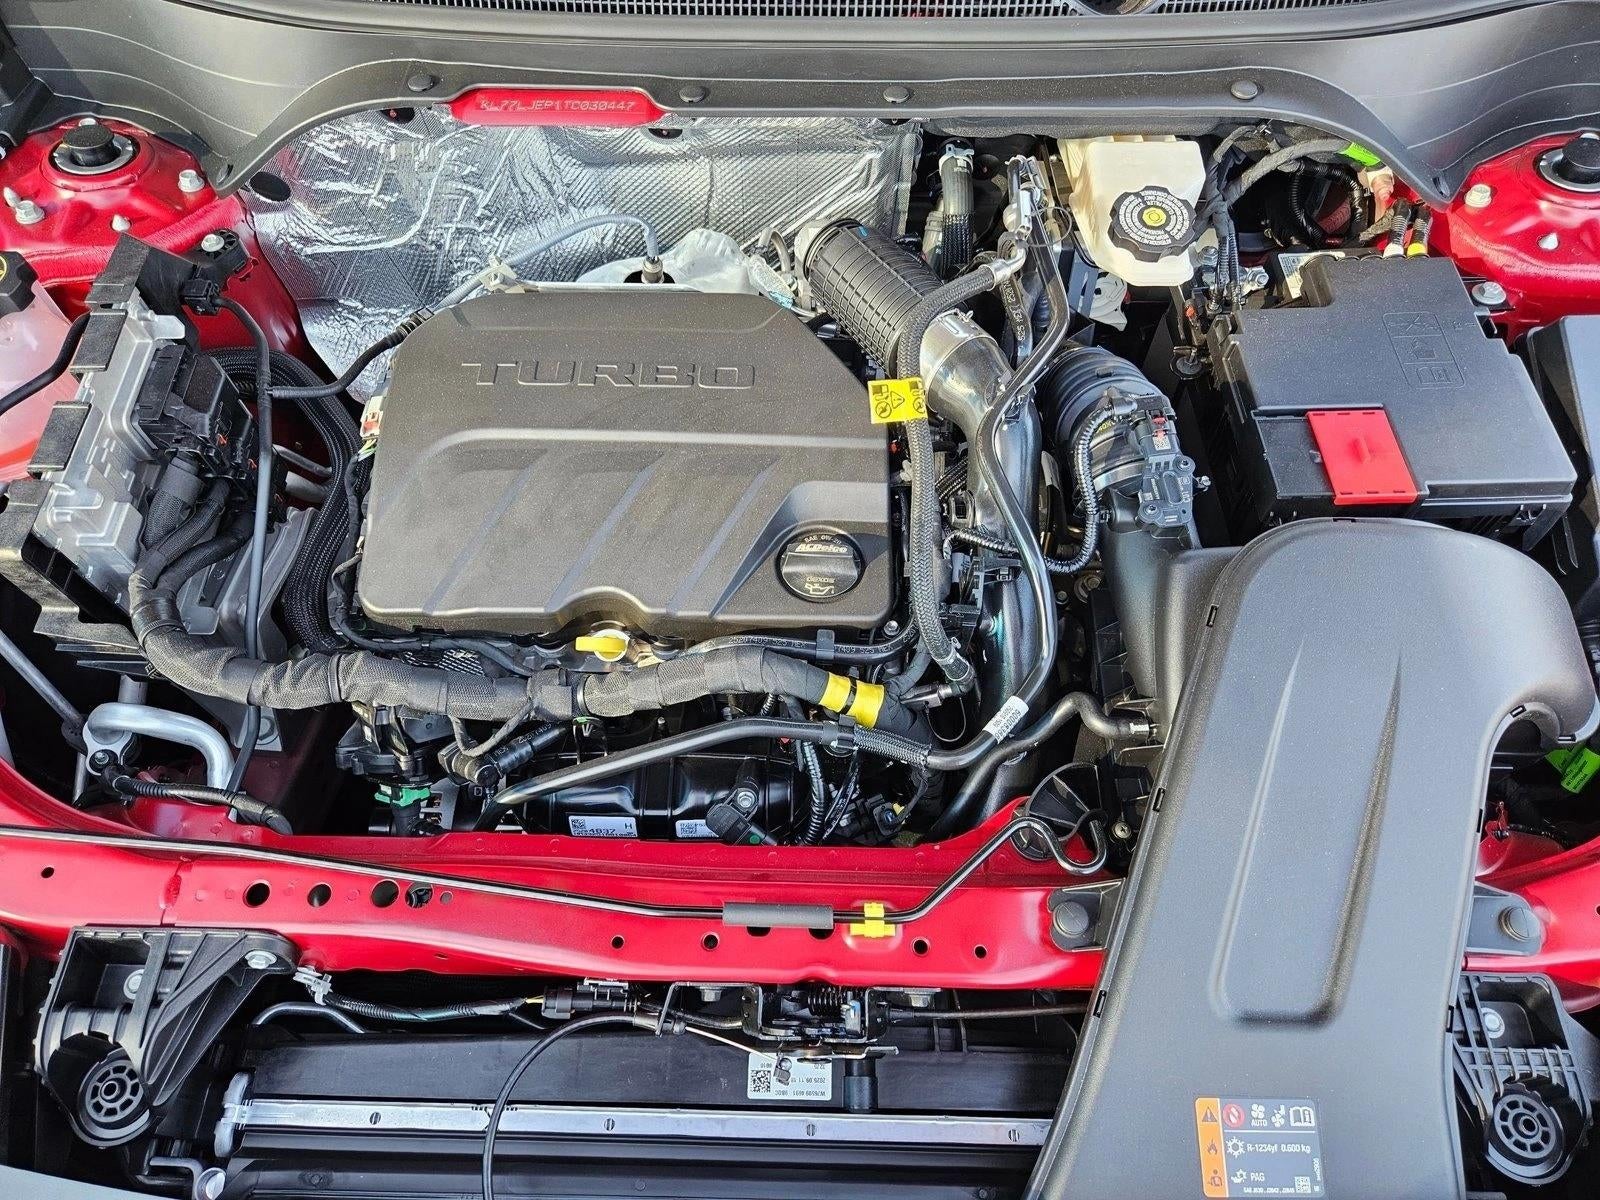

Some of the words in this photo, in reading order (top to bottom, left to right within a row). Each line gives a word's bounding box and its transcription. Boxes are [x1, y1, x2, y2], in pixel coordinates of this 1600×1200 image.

[461, 361, 755, 389] TURBO
[1251, 1119, 1268, 1127] AUTO
[1246, 1143, 1278, 1154] R-1234yf
[1302, 1143, 1312, 1154] kg
[1250, 1172, 1265, 1182] PAG
